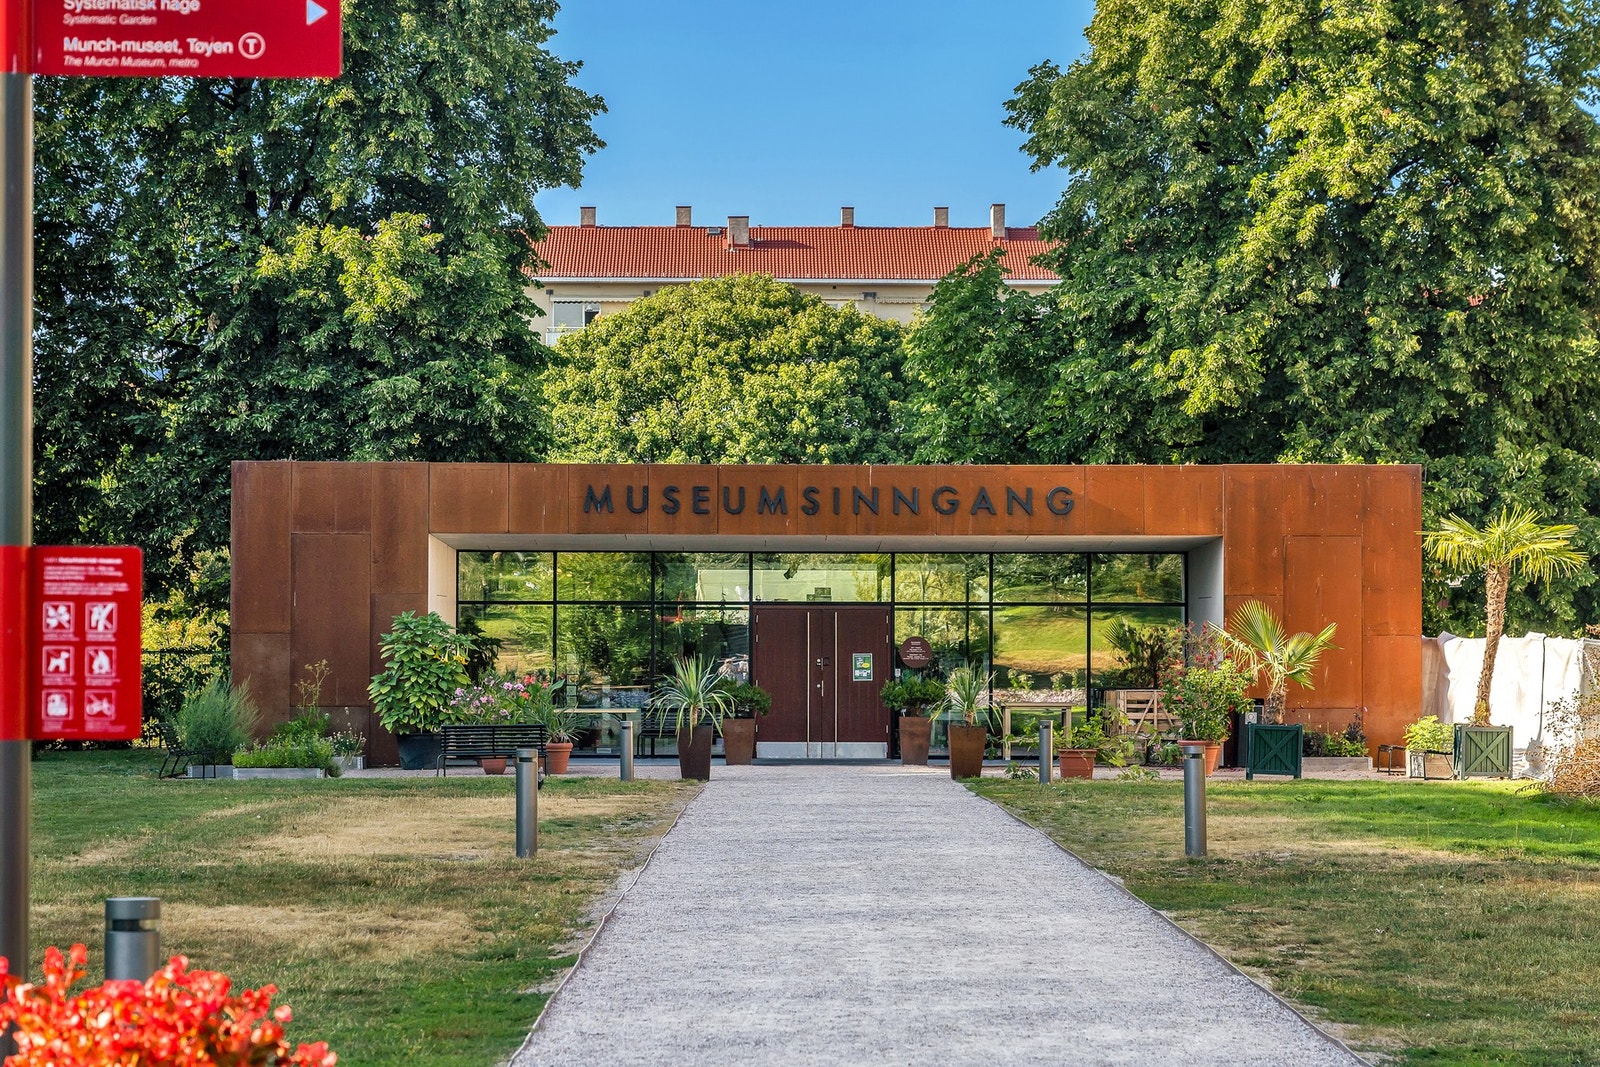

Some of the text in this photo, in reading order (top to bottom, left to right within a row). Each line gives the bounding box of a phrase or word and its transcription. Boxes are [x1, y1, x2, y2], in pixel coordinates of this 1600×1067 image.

[63, 0, 201, 15] Systematisk hage
[63, 12, 158, 26] Systematic Garden
[63, 36, 183, 55] Munch-museet,
[64, 55, 200, 68] The Munch Museum, metro
[583, 484, 1075, 517] MUSEUMSINNGANG
